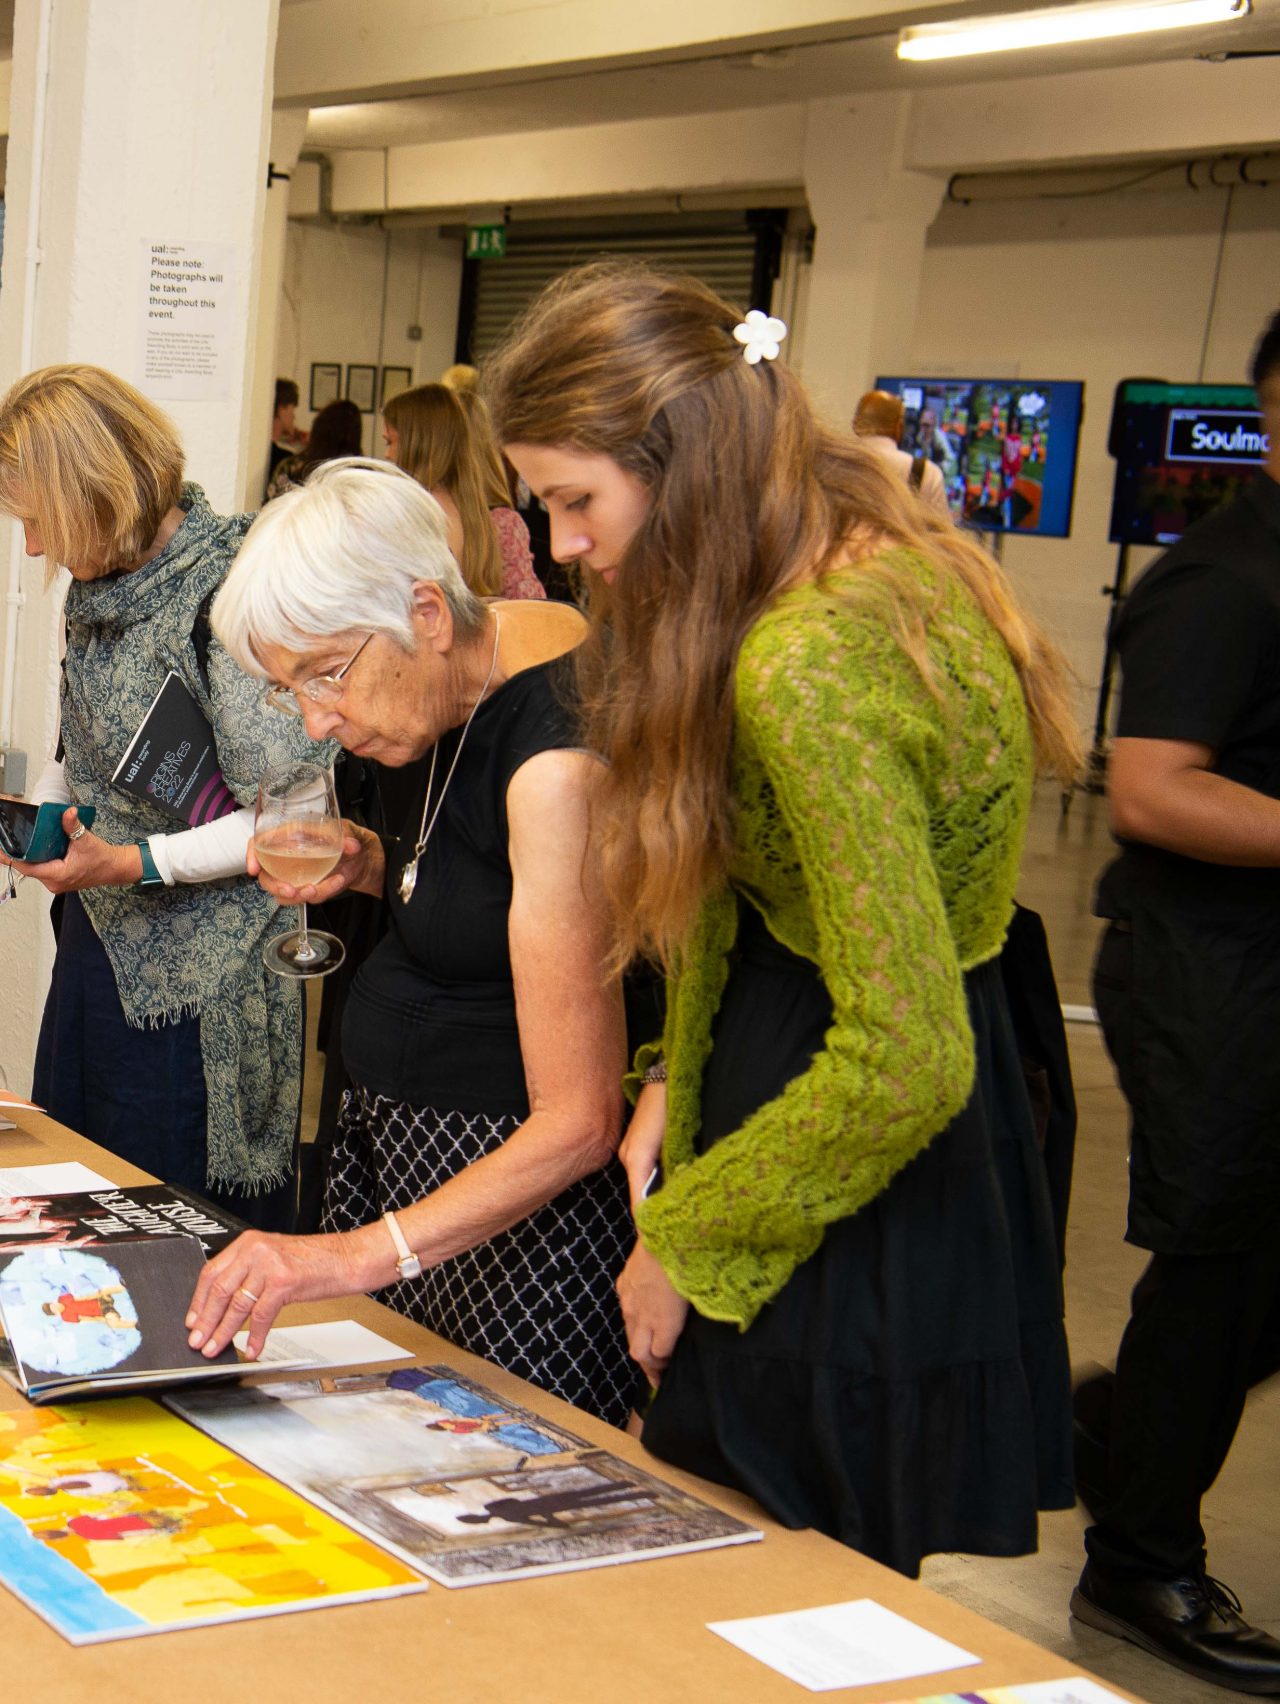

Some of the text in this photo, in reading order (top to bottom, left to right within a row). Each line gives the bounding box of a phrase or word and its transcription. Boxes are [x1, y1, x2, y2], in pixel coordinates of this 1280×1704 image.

[151, 256, 205, 269] Please note:
[150, 270, 223, 283] Photographs will
[150, 284, 187, 293] be taken
[149, 296, 216, 308] throughout this
[148, 311, 175, 319] event.
[125, 760, 142, 783] ual:
[153, 741, 191, 798] CREATIVES
[162, 774, 184, 804] 2022
[80, 1214, 134, 1236] THE
[147, 1200, 228, 1235] HOUSE
